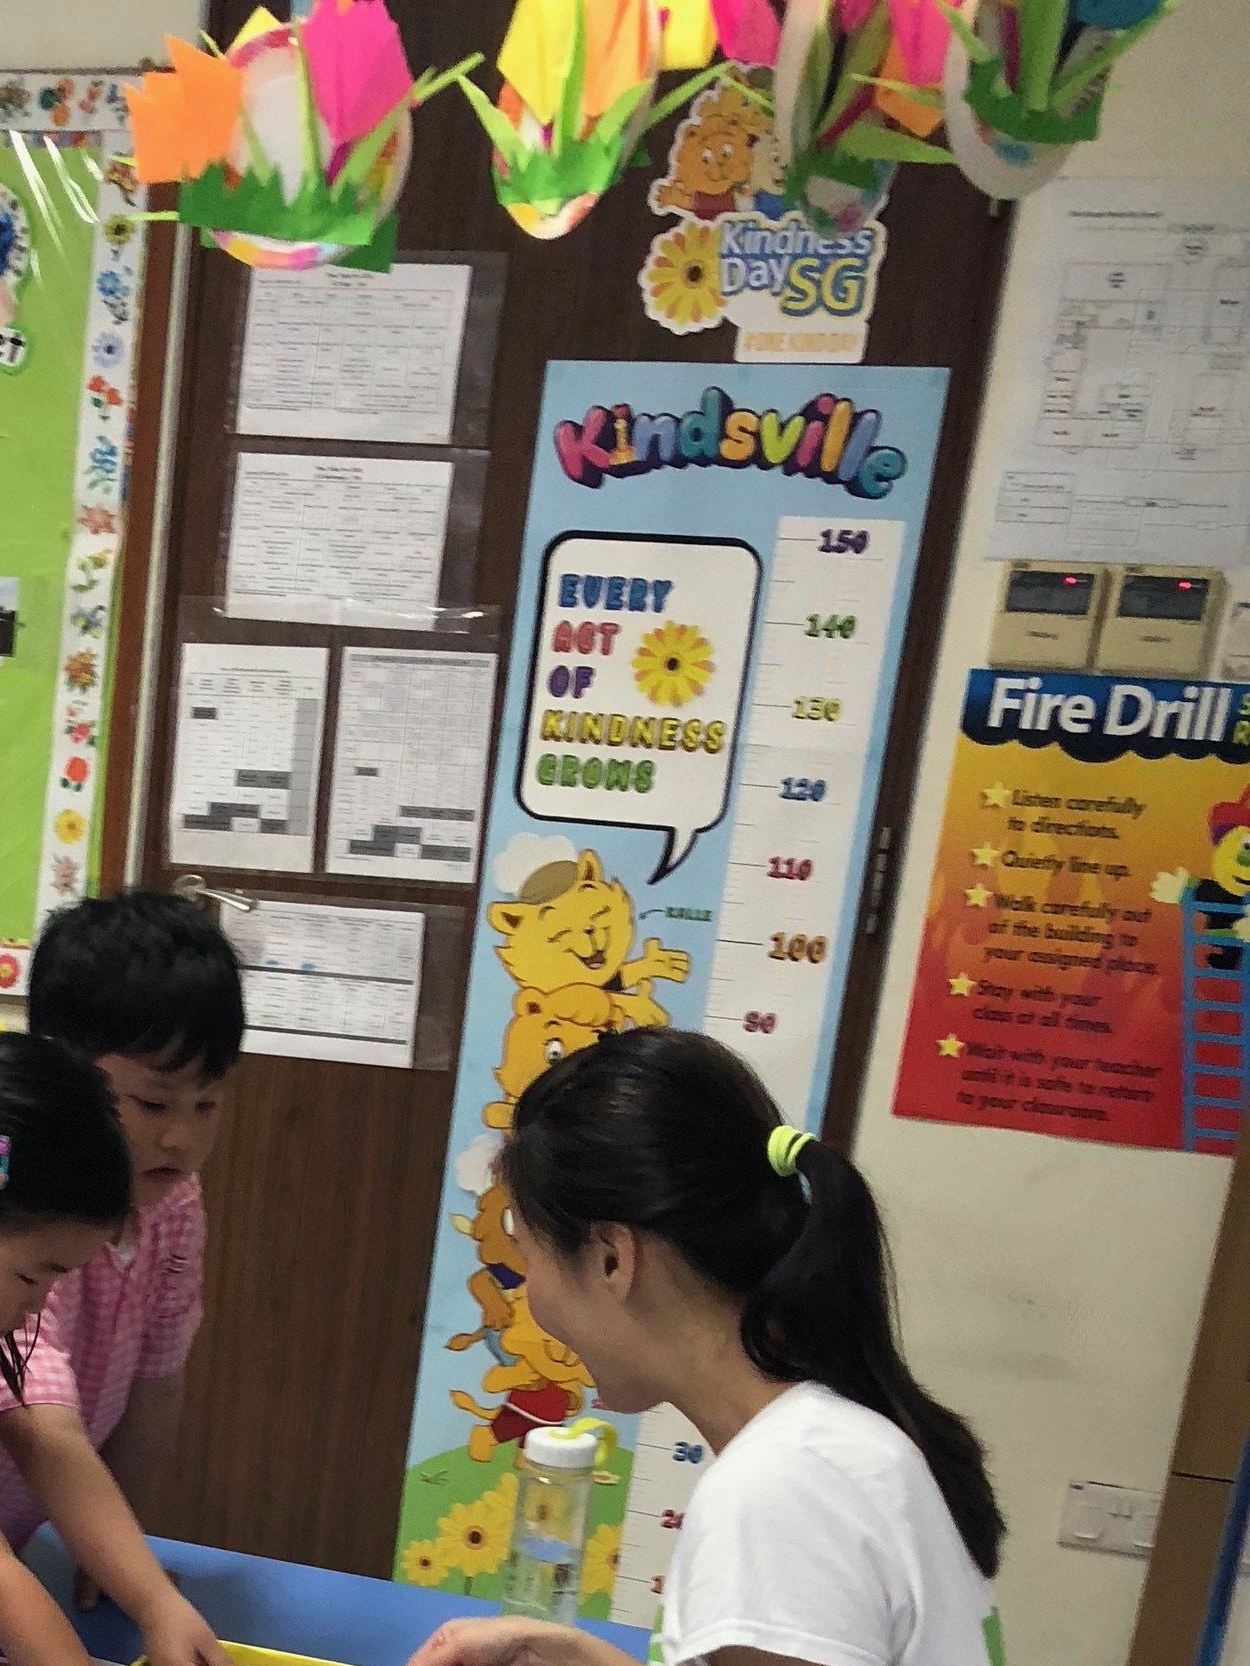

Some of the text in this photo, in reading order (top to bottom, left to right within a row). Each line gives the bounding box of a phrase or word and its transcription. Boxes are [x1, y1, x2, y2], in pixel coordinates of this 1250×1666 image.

[555, 386, 907, 499] Kindsville
[818, 529, 869, 554] 150
[558, 573, 673, 613] EVERY
[553, 620, 620, 655] ACT
[804, 613, 857, 639] 140
[548, 665, 594, 698] OF
[792, 696, 842, 722] 130
[987, 677, 1097, 733] Fire
[1103, 684, 1231, 742] Drill
[540, 710, 726, 753] KINDNESS
[537, 753, 656, 793] GROWS
[779, 777, 827, 802] 120
[1066, 796, 1147, 820] carefully
[767, 856, 813, 881] 110
[1001, 850, 1066, 876] Quietly
[768, 932, 828, 964] 100
[743, 1011, 777, 1034] 90
[673, 1441, 704, 1464] 30
